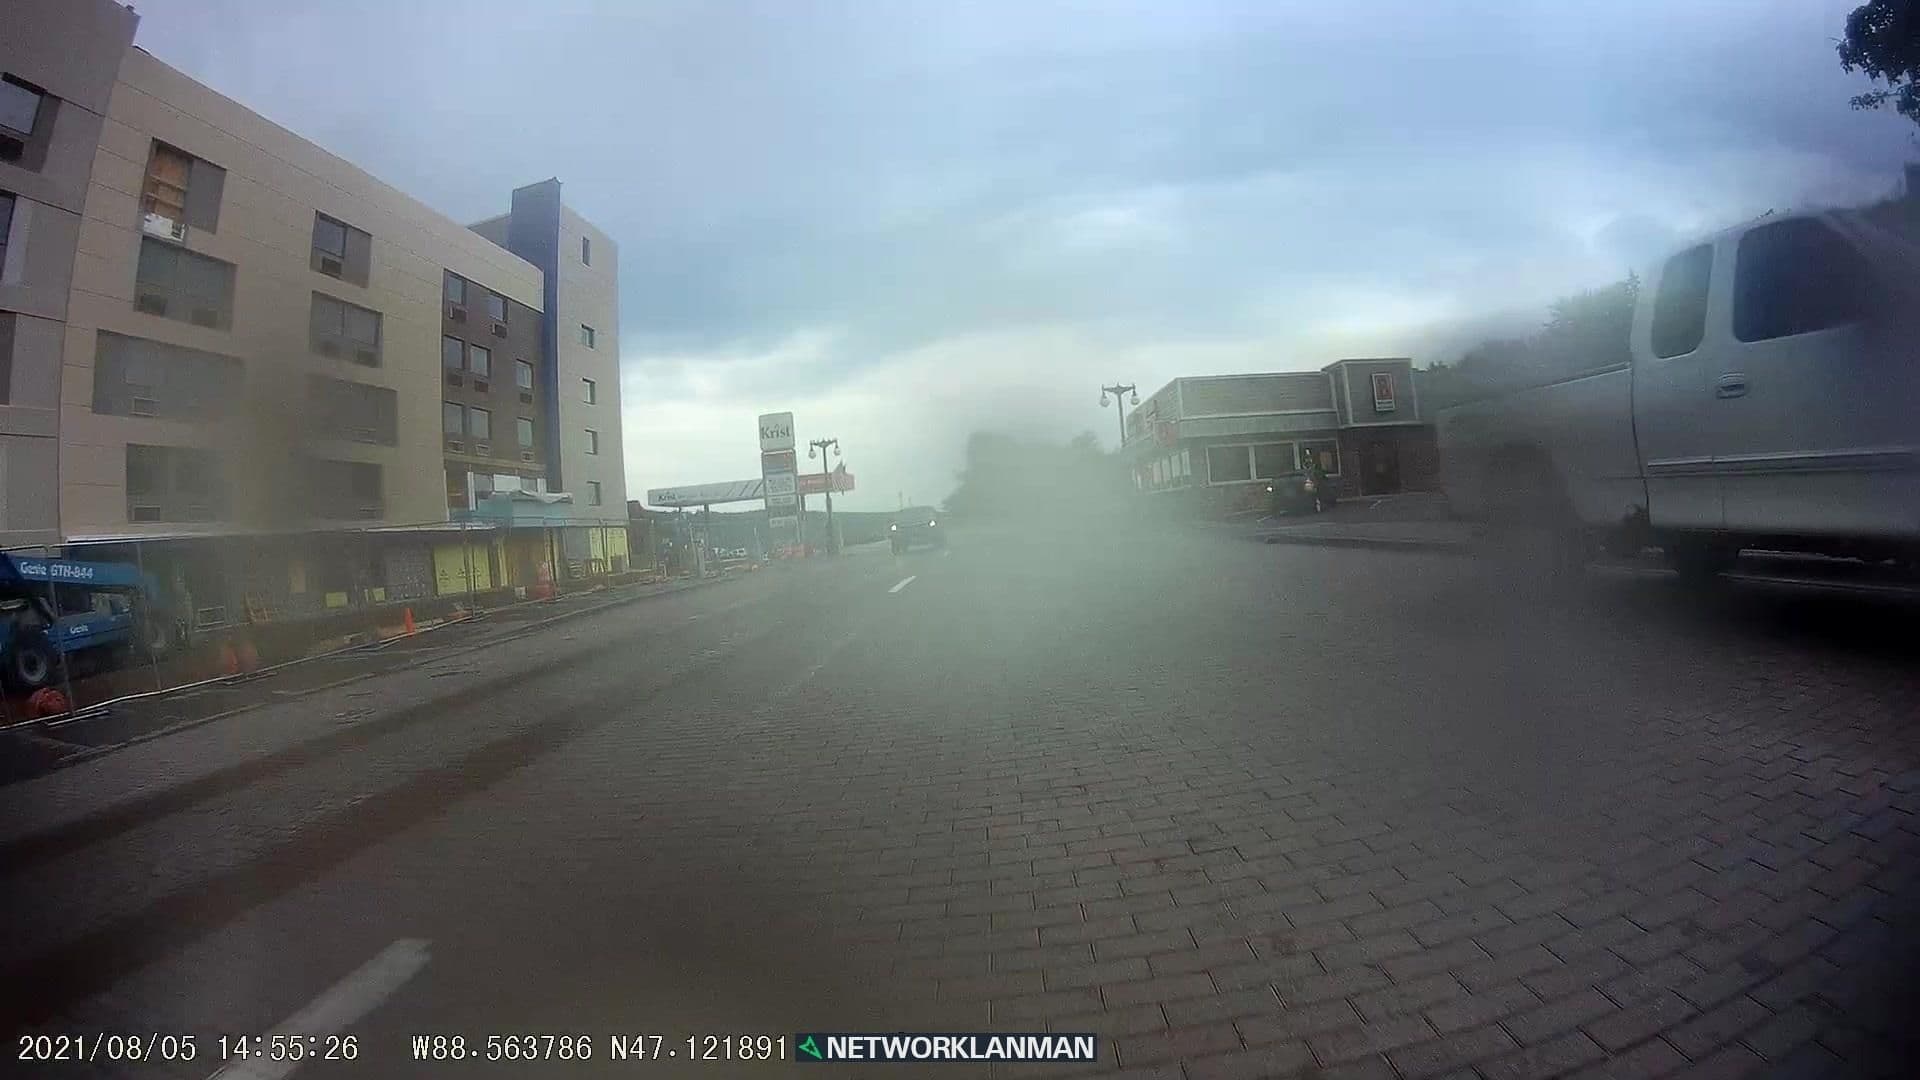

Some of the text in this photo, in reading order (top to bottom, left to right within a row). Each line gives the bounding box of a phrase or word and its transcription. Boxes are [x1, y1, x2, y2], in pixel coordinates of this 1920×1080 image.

[761, 425, 790, 440] Krist
[20, 562, 93, 579] Genie GTH-844
